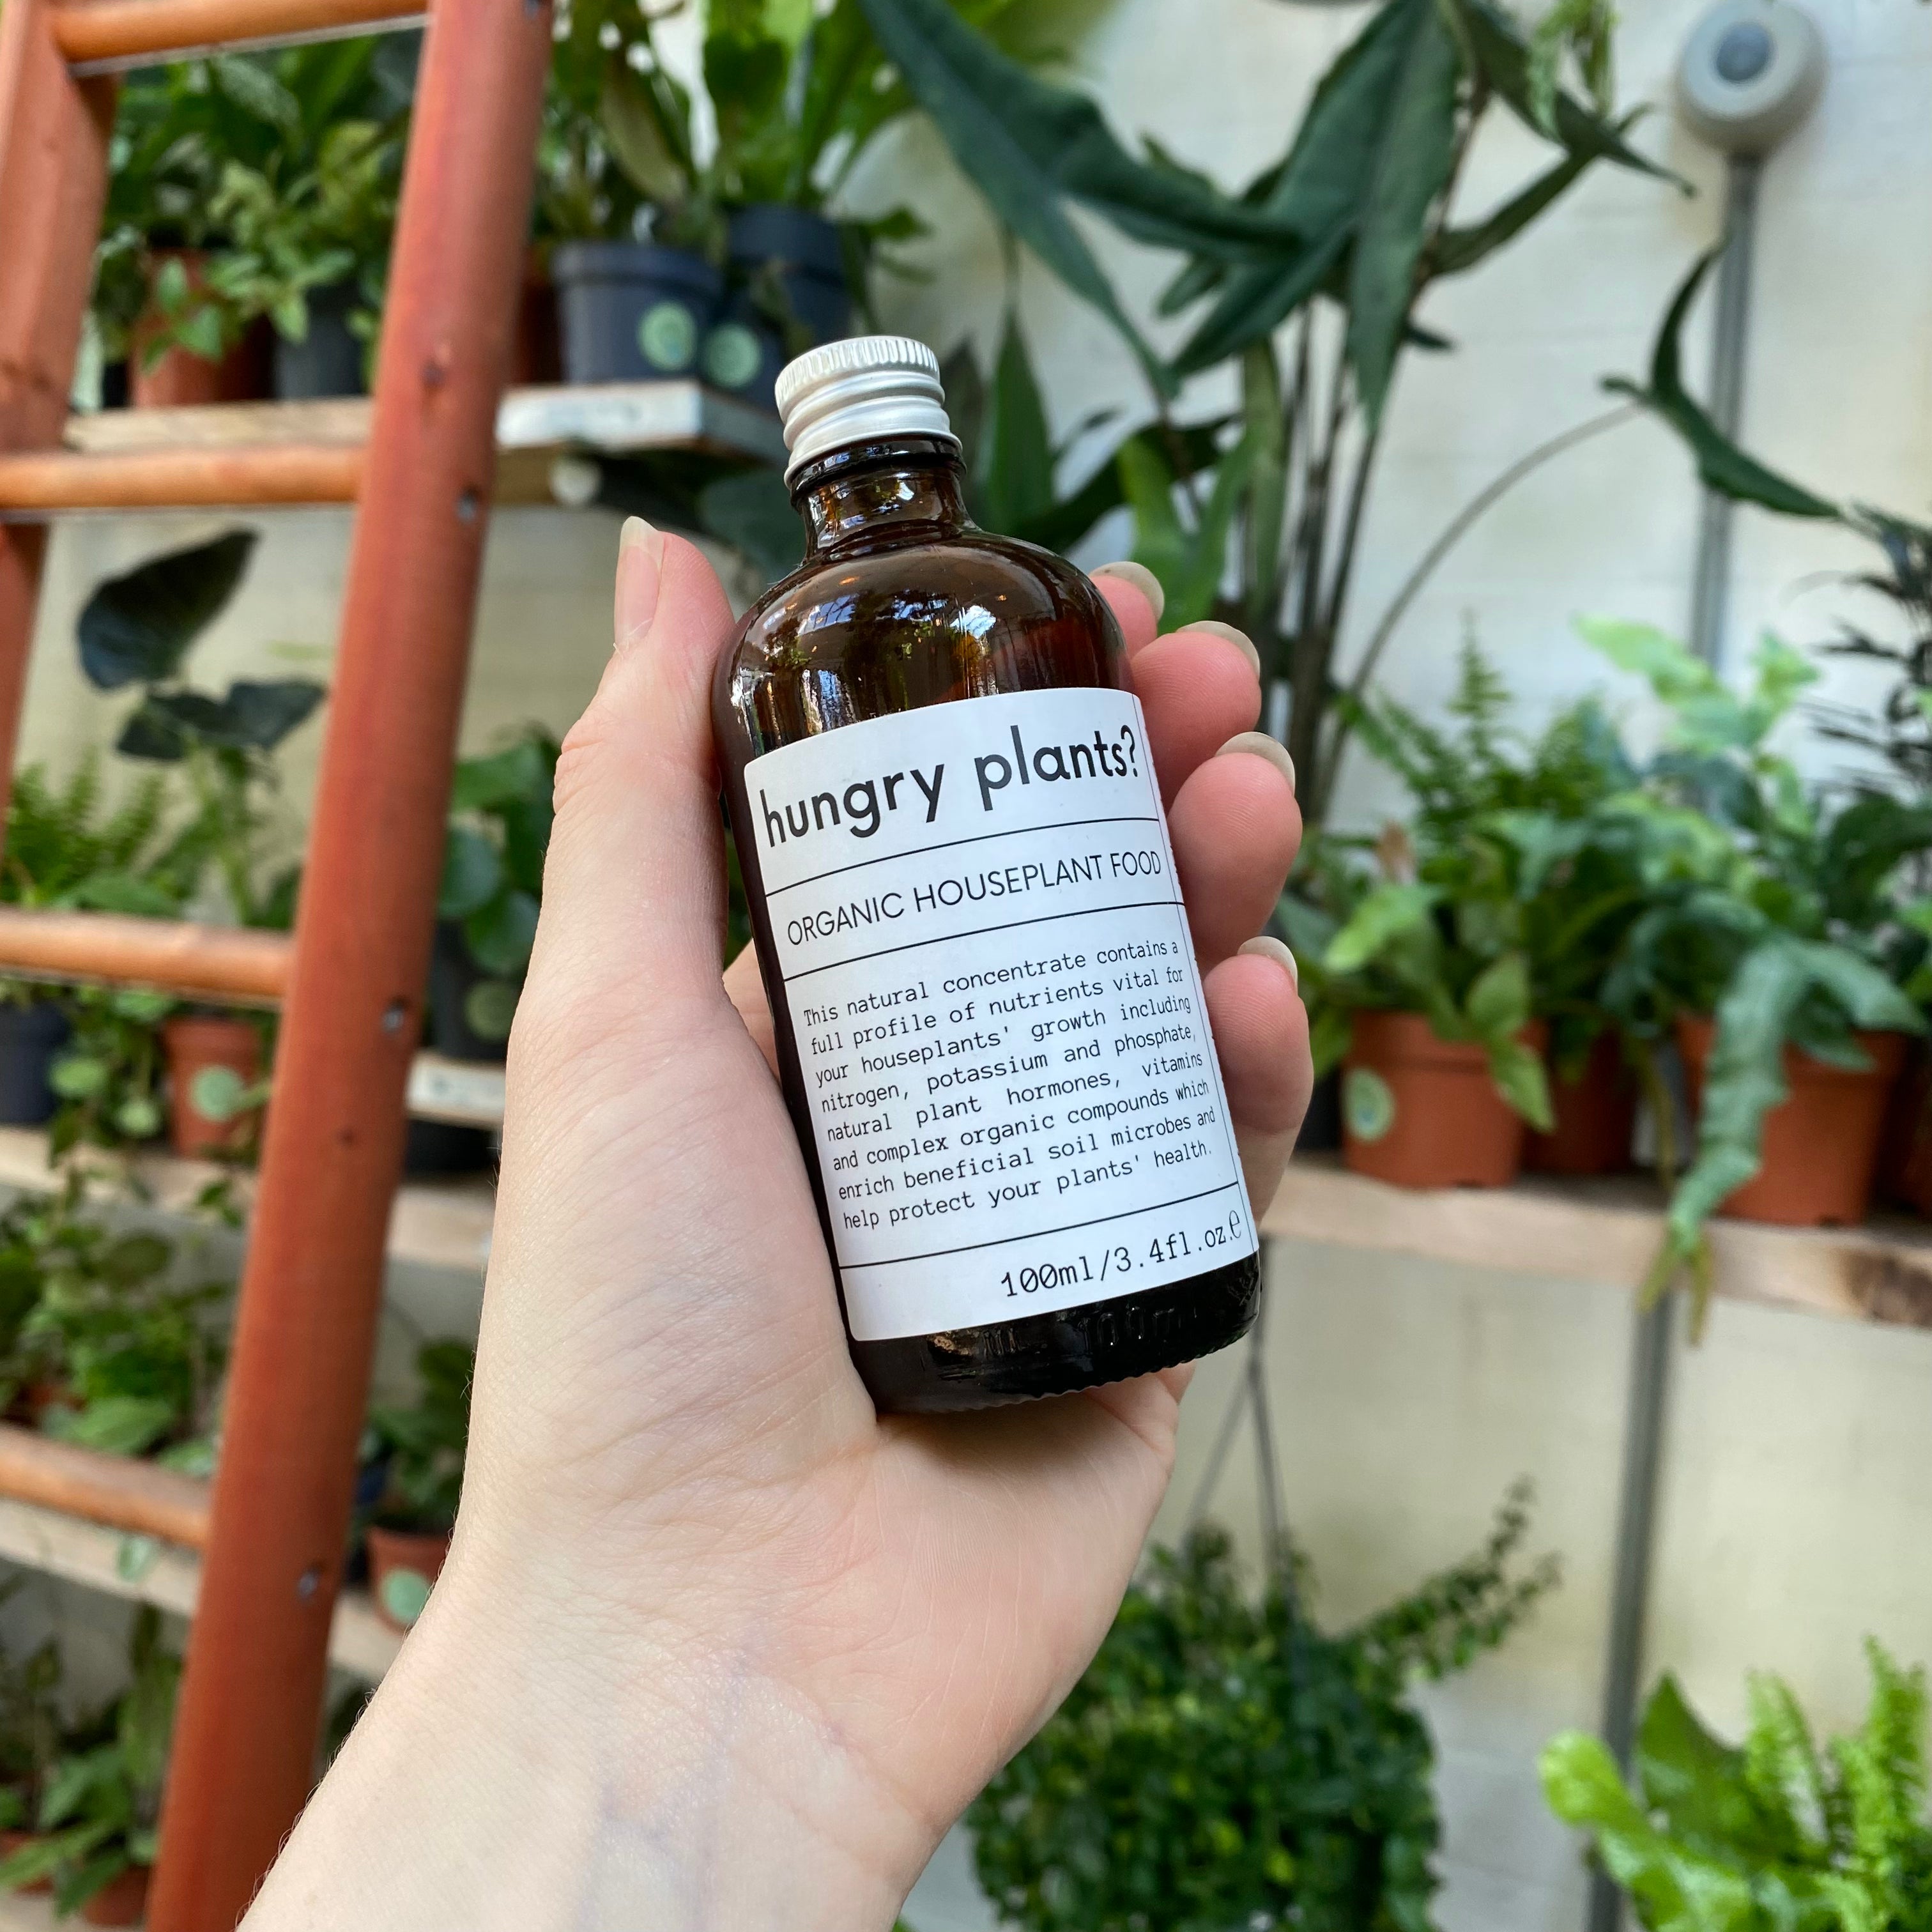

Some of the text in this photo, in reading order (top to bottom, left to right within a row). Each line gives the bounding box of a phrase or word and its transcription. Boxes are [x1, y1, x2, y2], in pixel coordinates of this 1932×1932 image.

[759, 724, 1138, 848] hungry plants?
[787, 850, 1162, 946] ORGANIC HOUSEPLANT FOOD
[803, 940, 1179, 1027] This natural concentrate contains a
[811, 966, 1183, 1055] full profile of nutrients vital for
[815, 995, 1191, 1089] your houseplants' growth including
[821, 1023, 1195, 1113] nitrogen, potassium and phosphate,
[827, 1052, 1203, 1142] natural plant hormones, vitamins
[833, 1078, 1209, 1171] and complex organic compounds which
[838, 1105, 1216, 1200] enrich beneficial soil microbes and
[843, 1139, 1211, 1230] help protect your plants' health.
